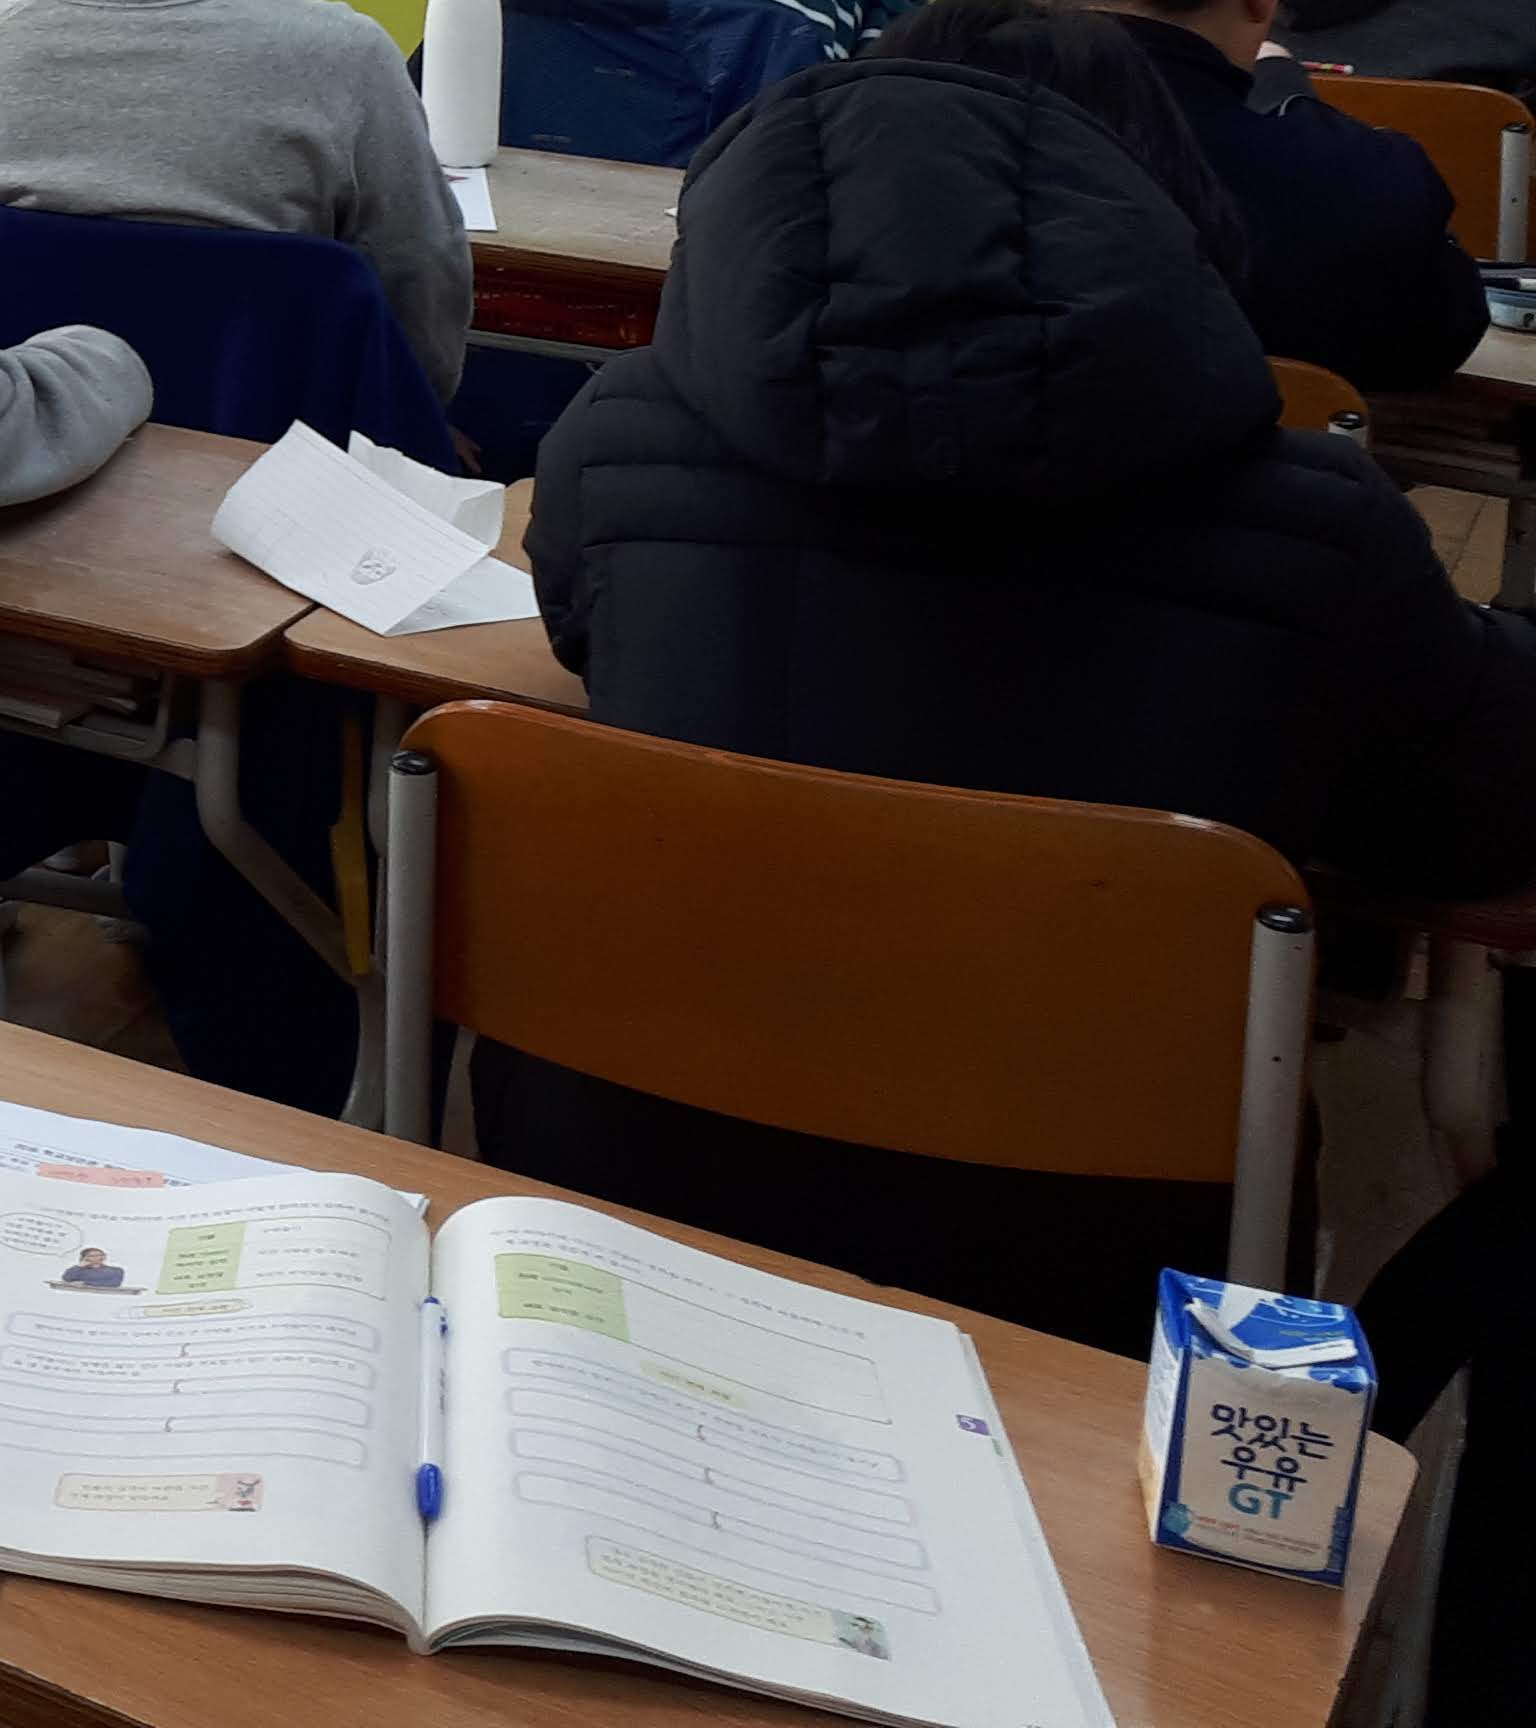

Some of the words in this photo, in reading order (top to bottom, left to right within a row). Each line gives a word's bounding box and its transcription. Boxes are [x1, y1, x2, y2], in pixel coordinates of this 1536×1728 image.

[1210, 1403, 1335, 1460] 맛있는
[1221, 1446, 1307, 1493] 우유
[1229, 1483, 1294, 1520] GT
